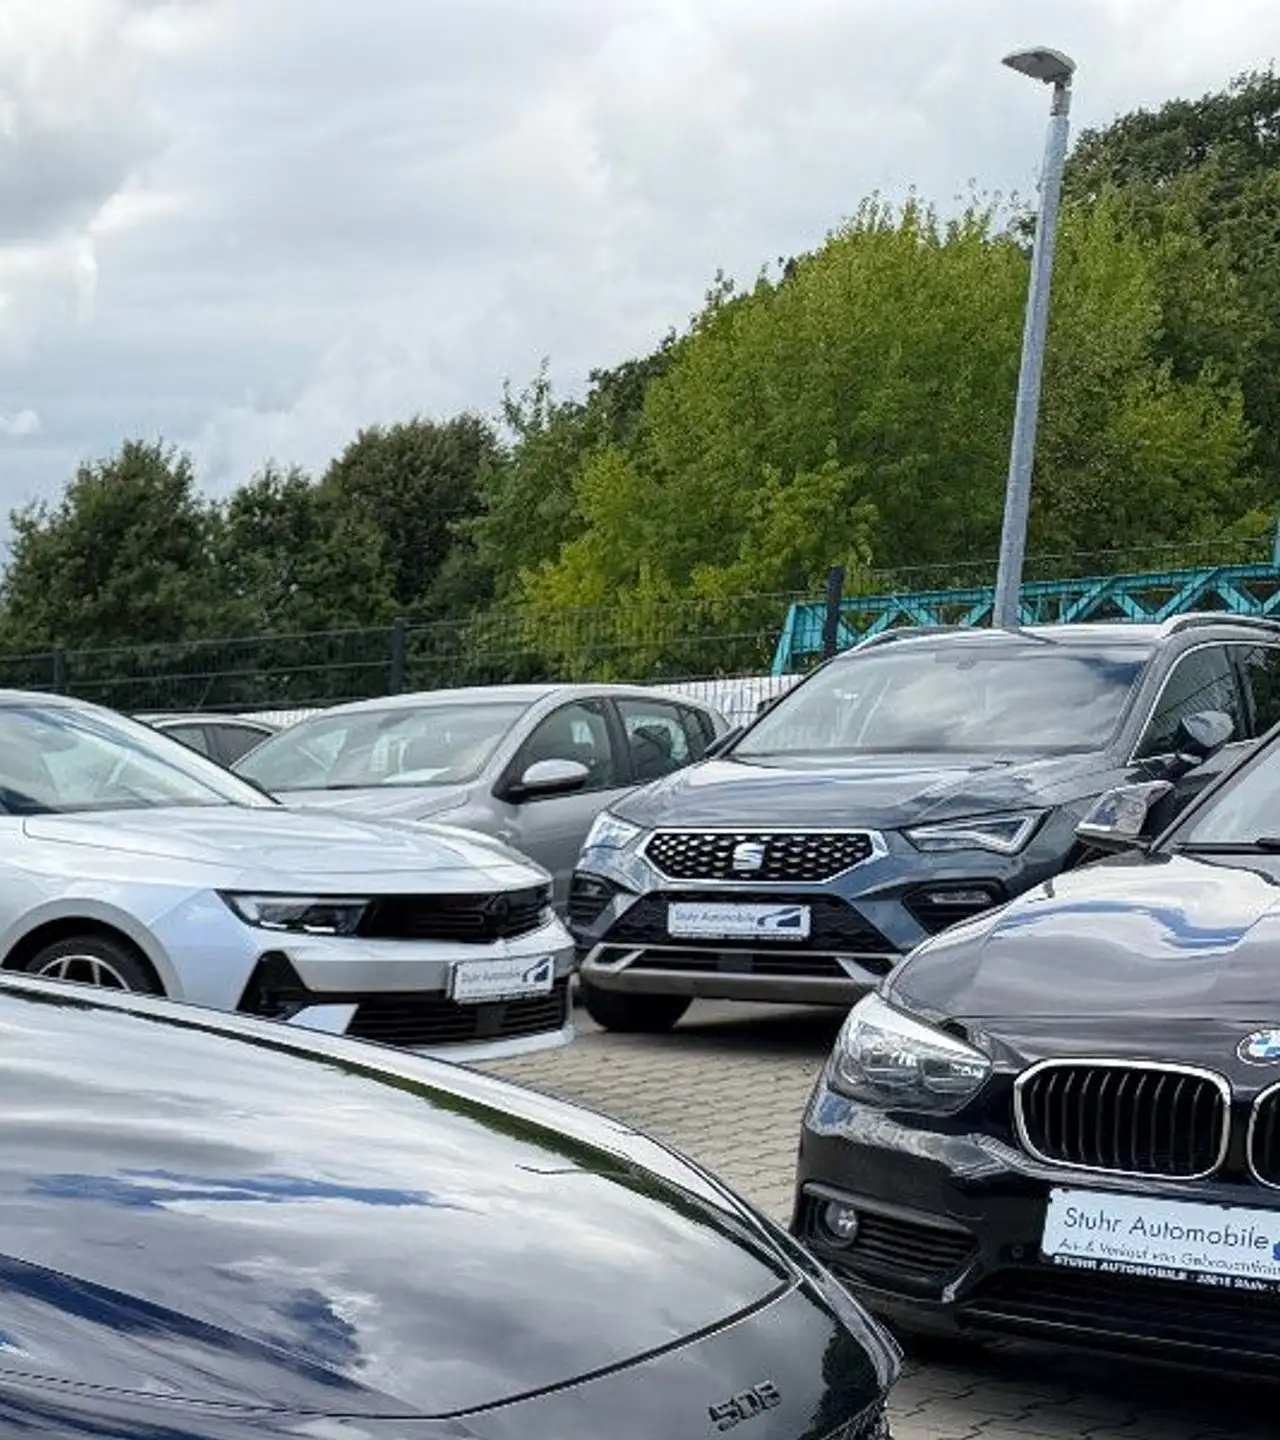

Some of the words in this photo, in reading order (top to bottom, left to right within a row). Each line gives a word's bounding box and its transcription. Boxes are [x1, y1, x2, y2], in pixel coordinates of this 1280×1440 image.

[1063, 1206, 1123, 1233] Stuhr
[1128, 1215, 1270, 1251] Automobile
[1054, 1255, 1098, 1271] STUHR
[1100, 1261, 1188, 1281] AUTOMOBILE
[708, 1380, 782, 1431] 508
